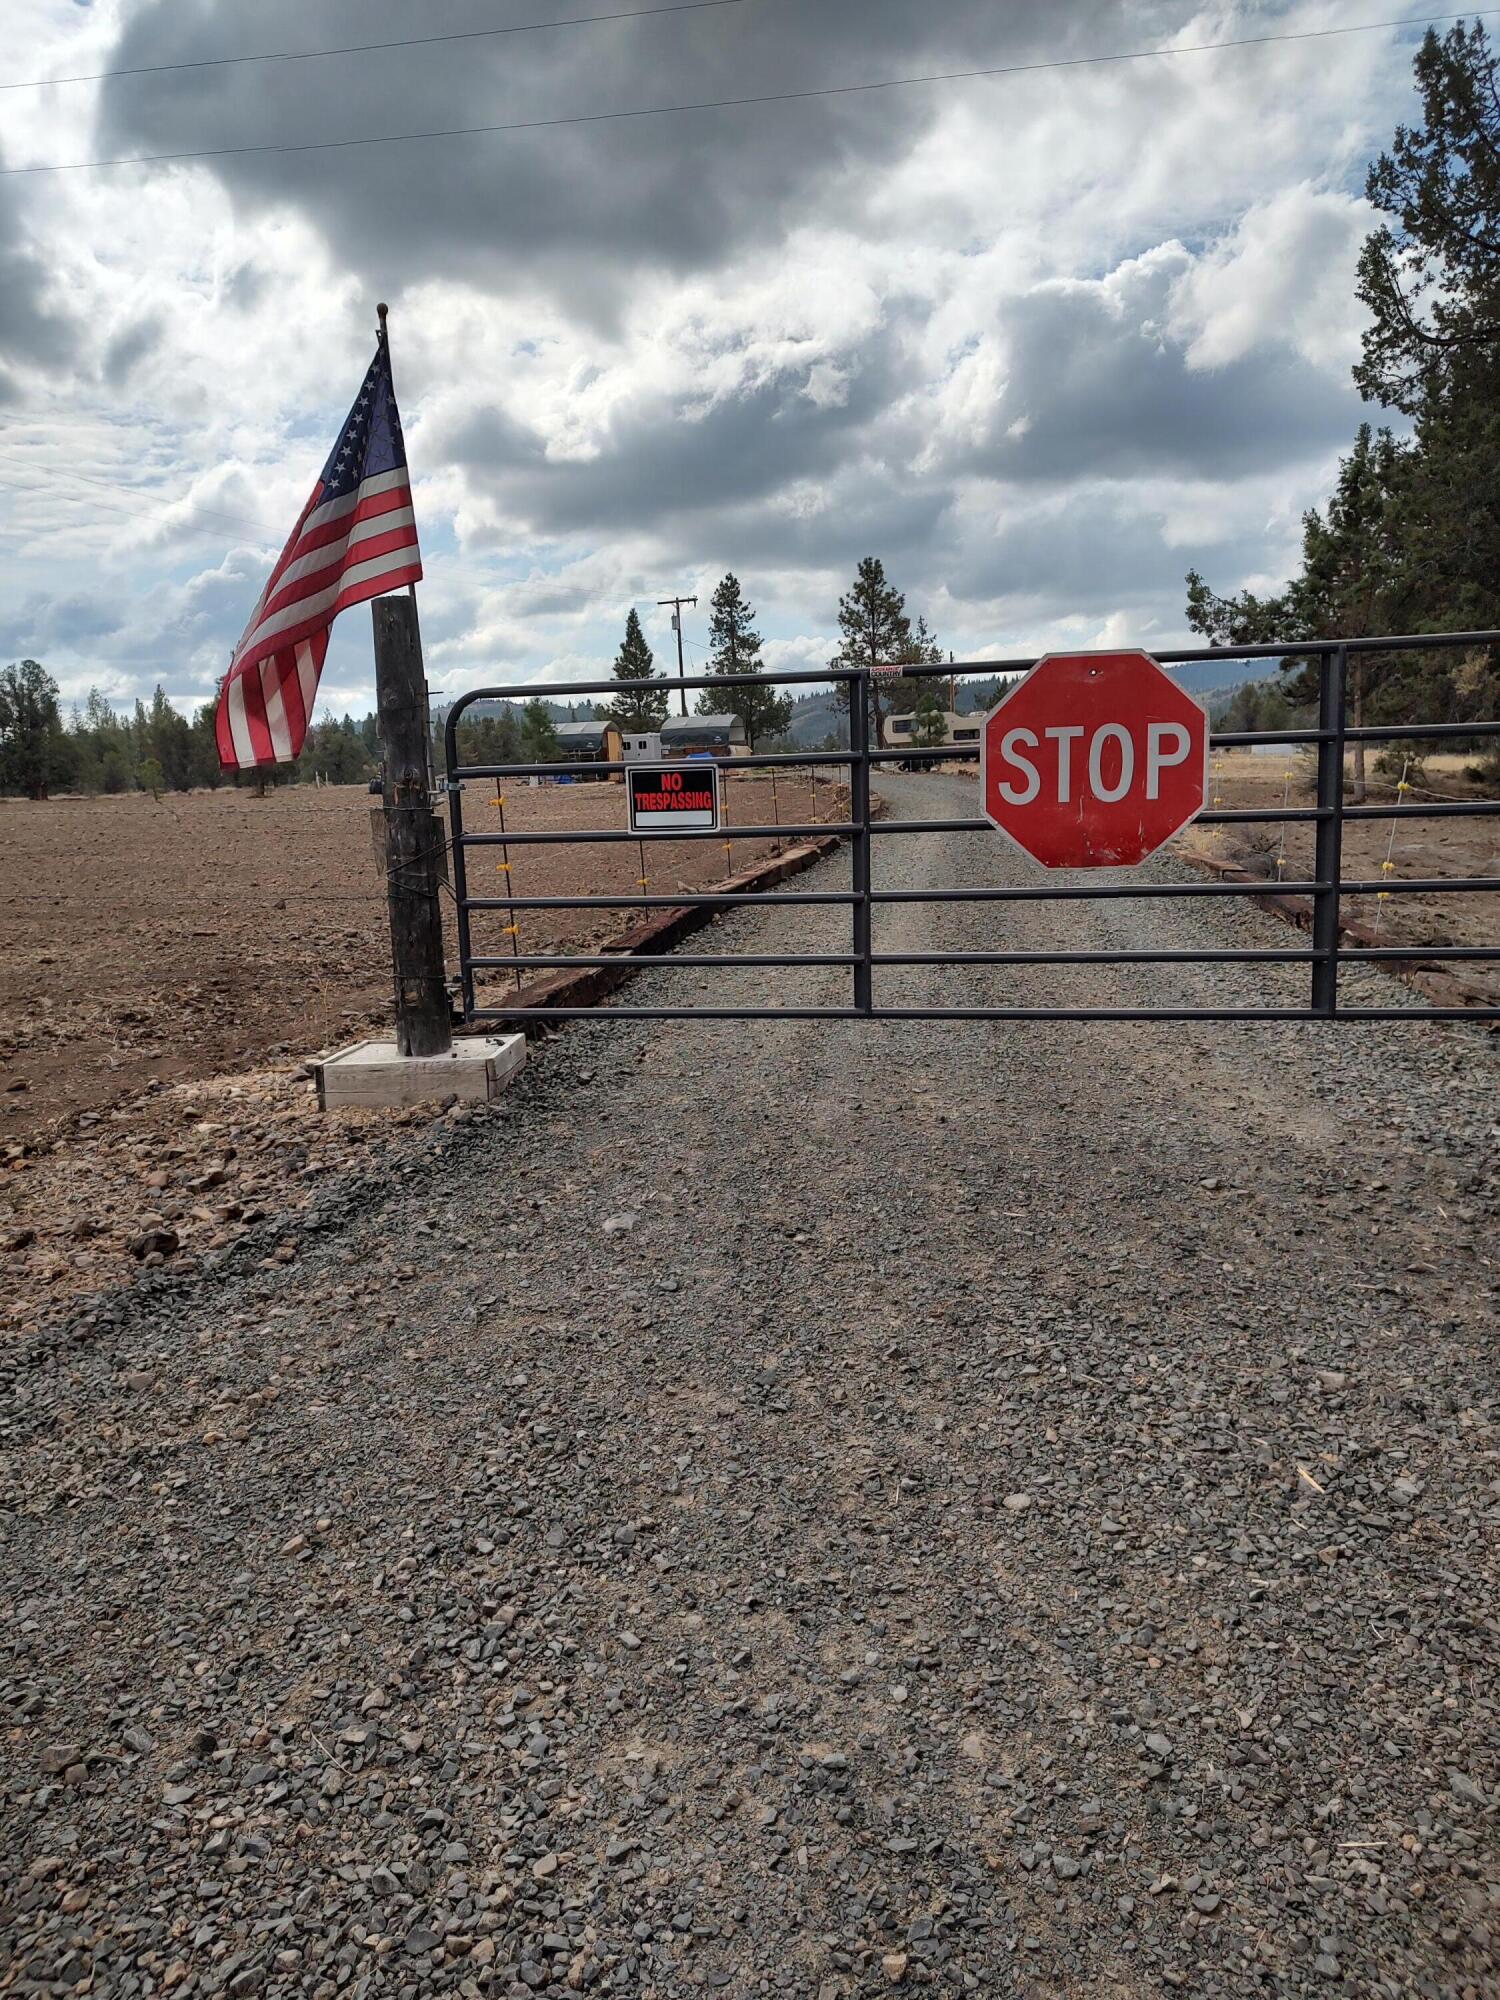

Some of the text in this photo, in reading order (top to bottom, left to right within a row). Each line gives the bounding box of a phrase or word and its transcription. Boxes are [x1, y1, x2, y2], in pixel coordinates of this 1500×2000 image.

[998, 722, 1191, 806] STOP
[661, 773, 682, 791] NO
[635, 791, 712, 810] TRESPASSING
